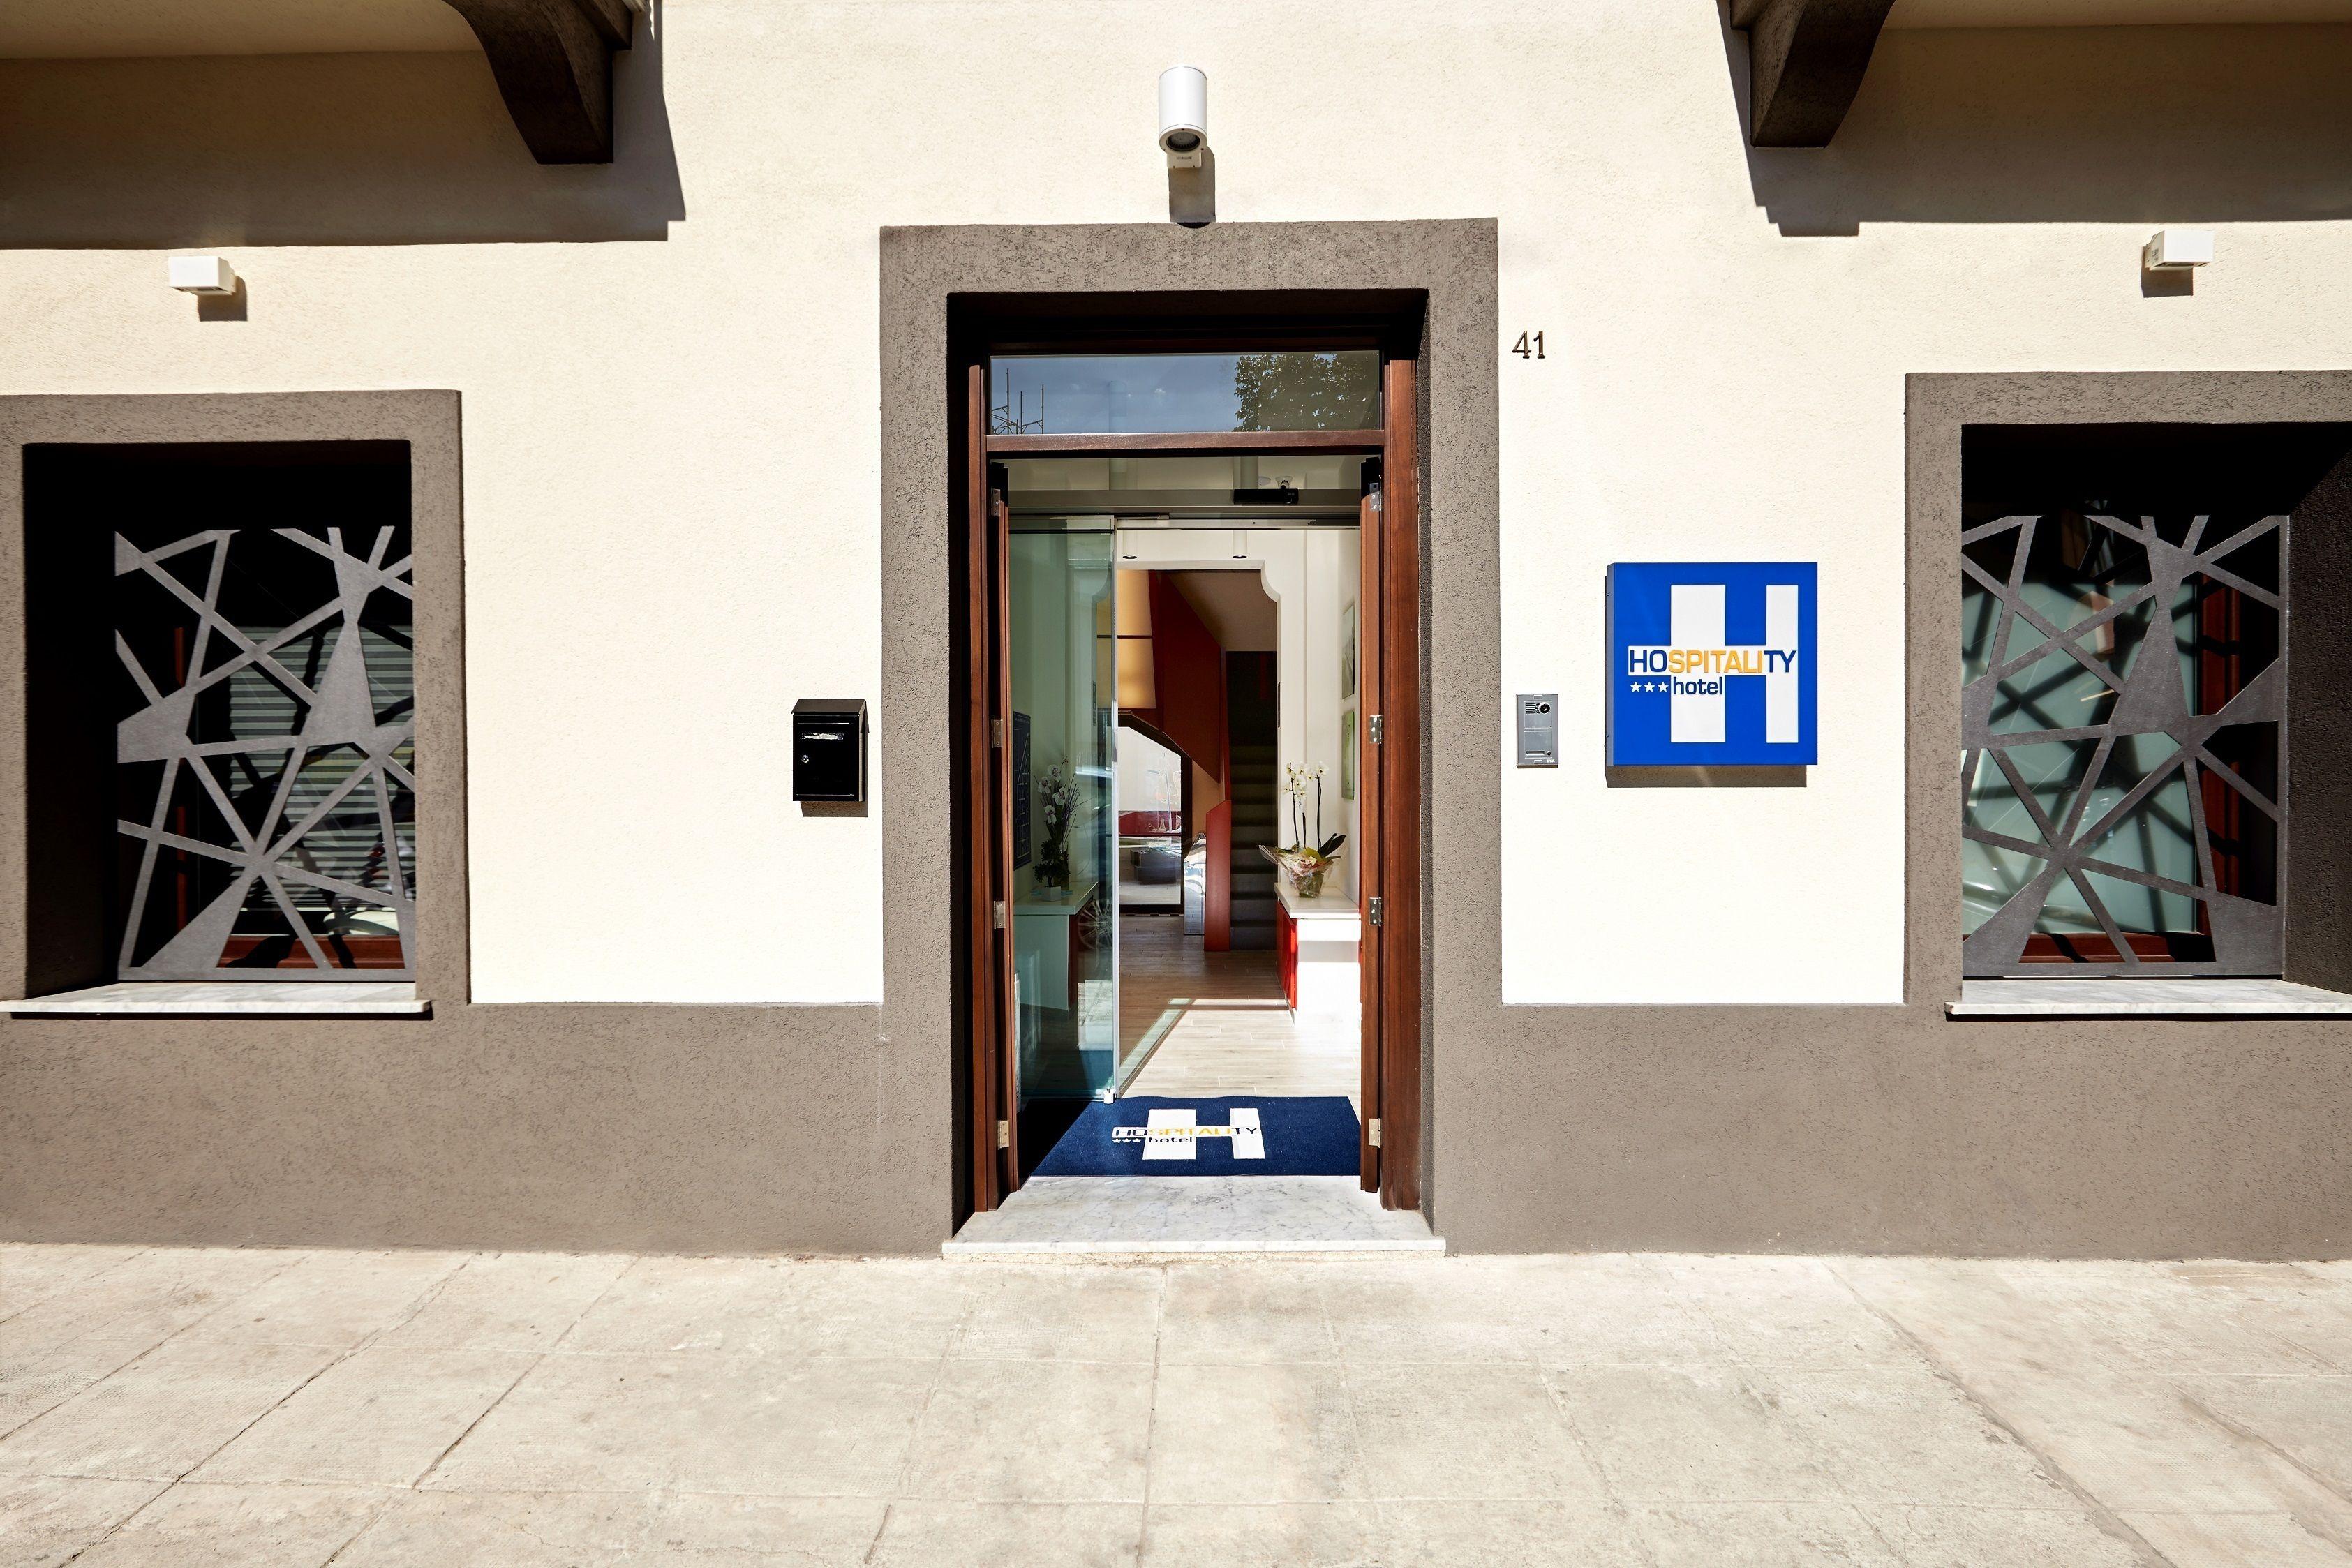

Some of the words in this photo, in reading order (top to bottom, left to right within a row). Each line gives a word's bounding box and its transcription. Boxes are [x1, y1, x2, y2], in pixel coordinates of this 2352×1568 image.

[1512, 330, 1545, 359] 41
[1630, 650, 1797, 673] HOSPITALITY
[1673, 676, 1723, 695] hotel
[1115, 1127, 1258, 1137] HOSPITALITY
